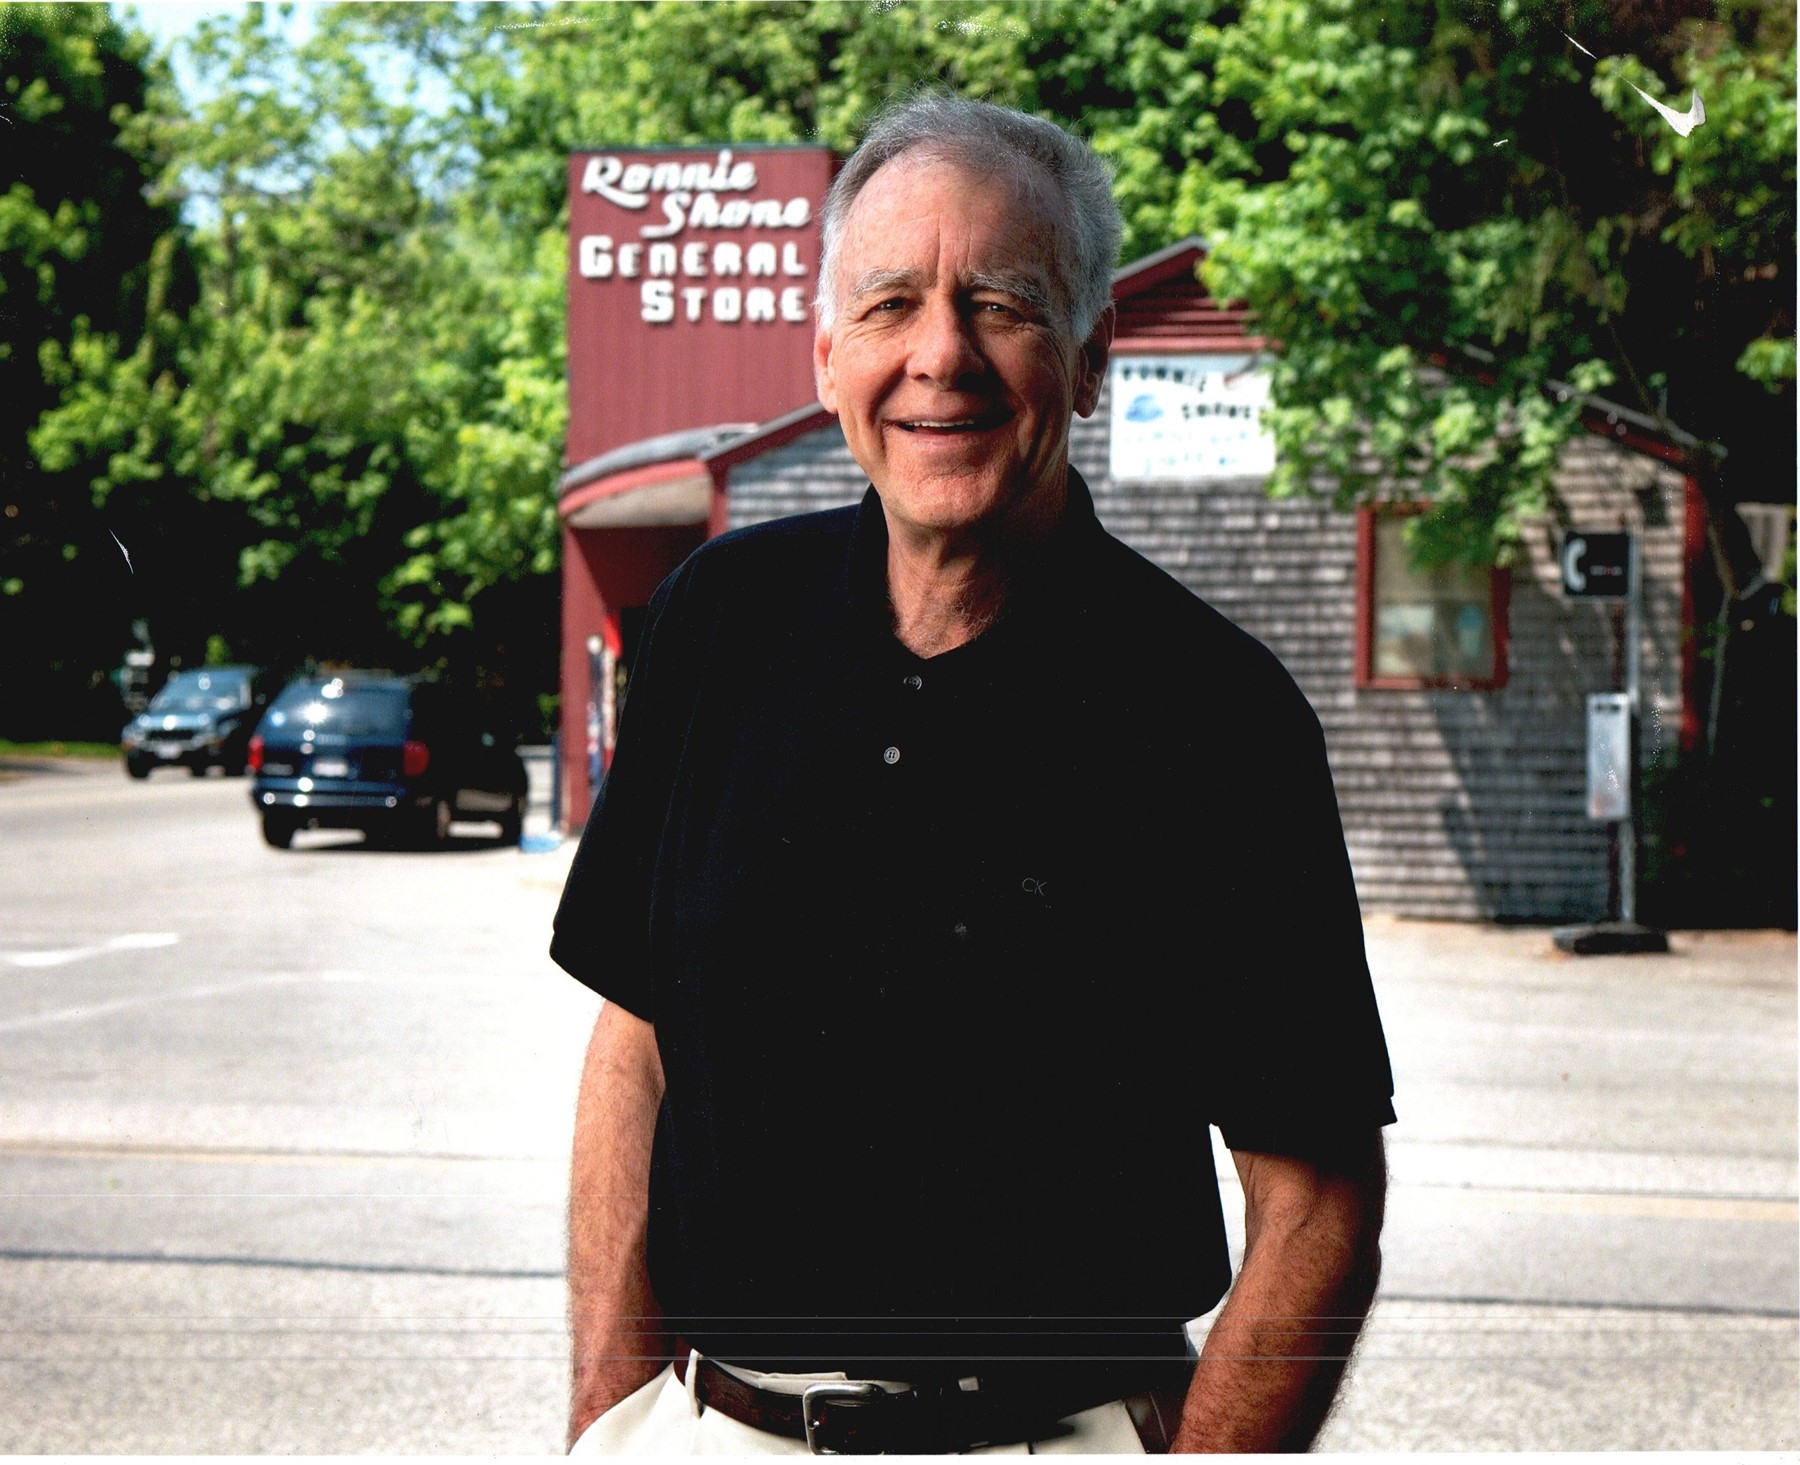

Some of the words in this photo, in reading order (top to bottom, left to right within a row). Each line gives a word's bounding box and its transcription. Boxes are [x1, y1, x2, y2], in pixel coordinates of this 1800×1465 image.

[582, 150, 756, 208] Ronnie
[641, 192, 811, 237] Shone
[641, 281, 807, 322] STORE
[1022, 877, 1048, 896] CK
